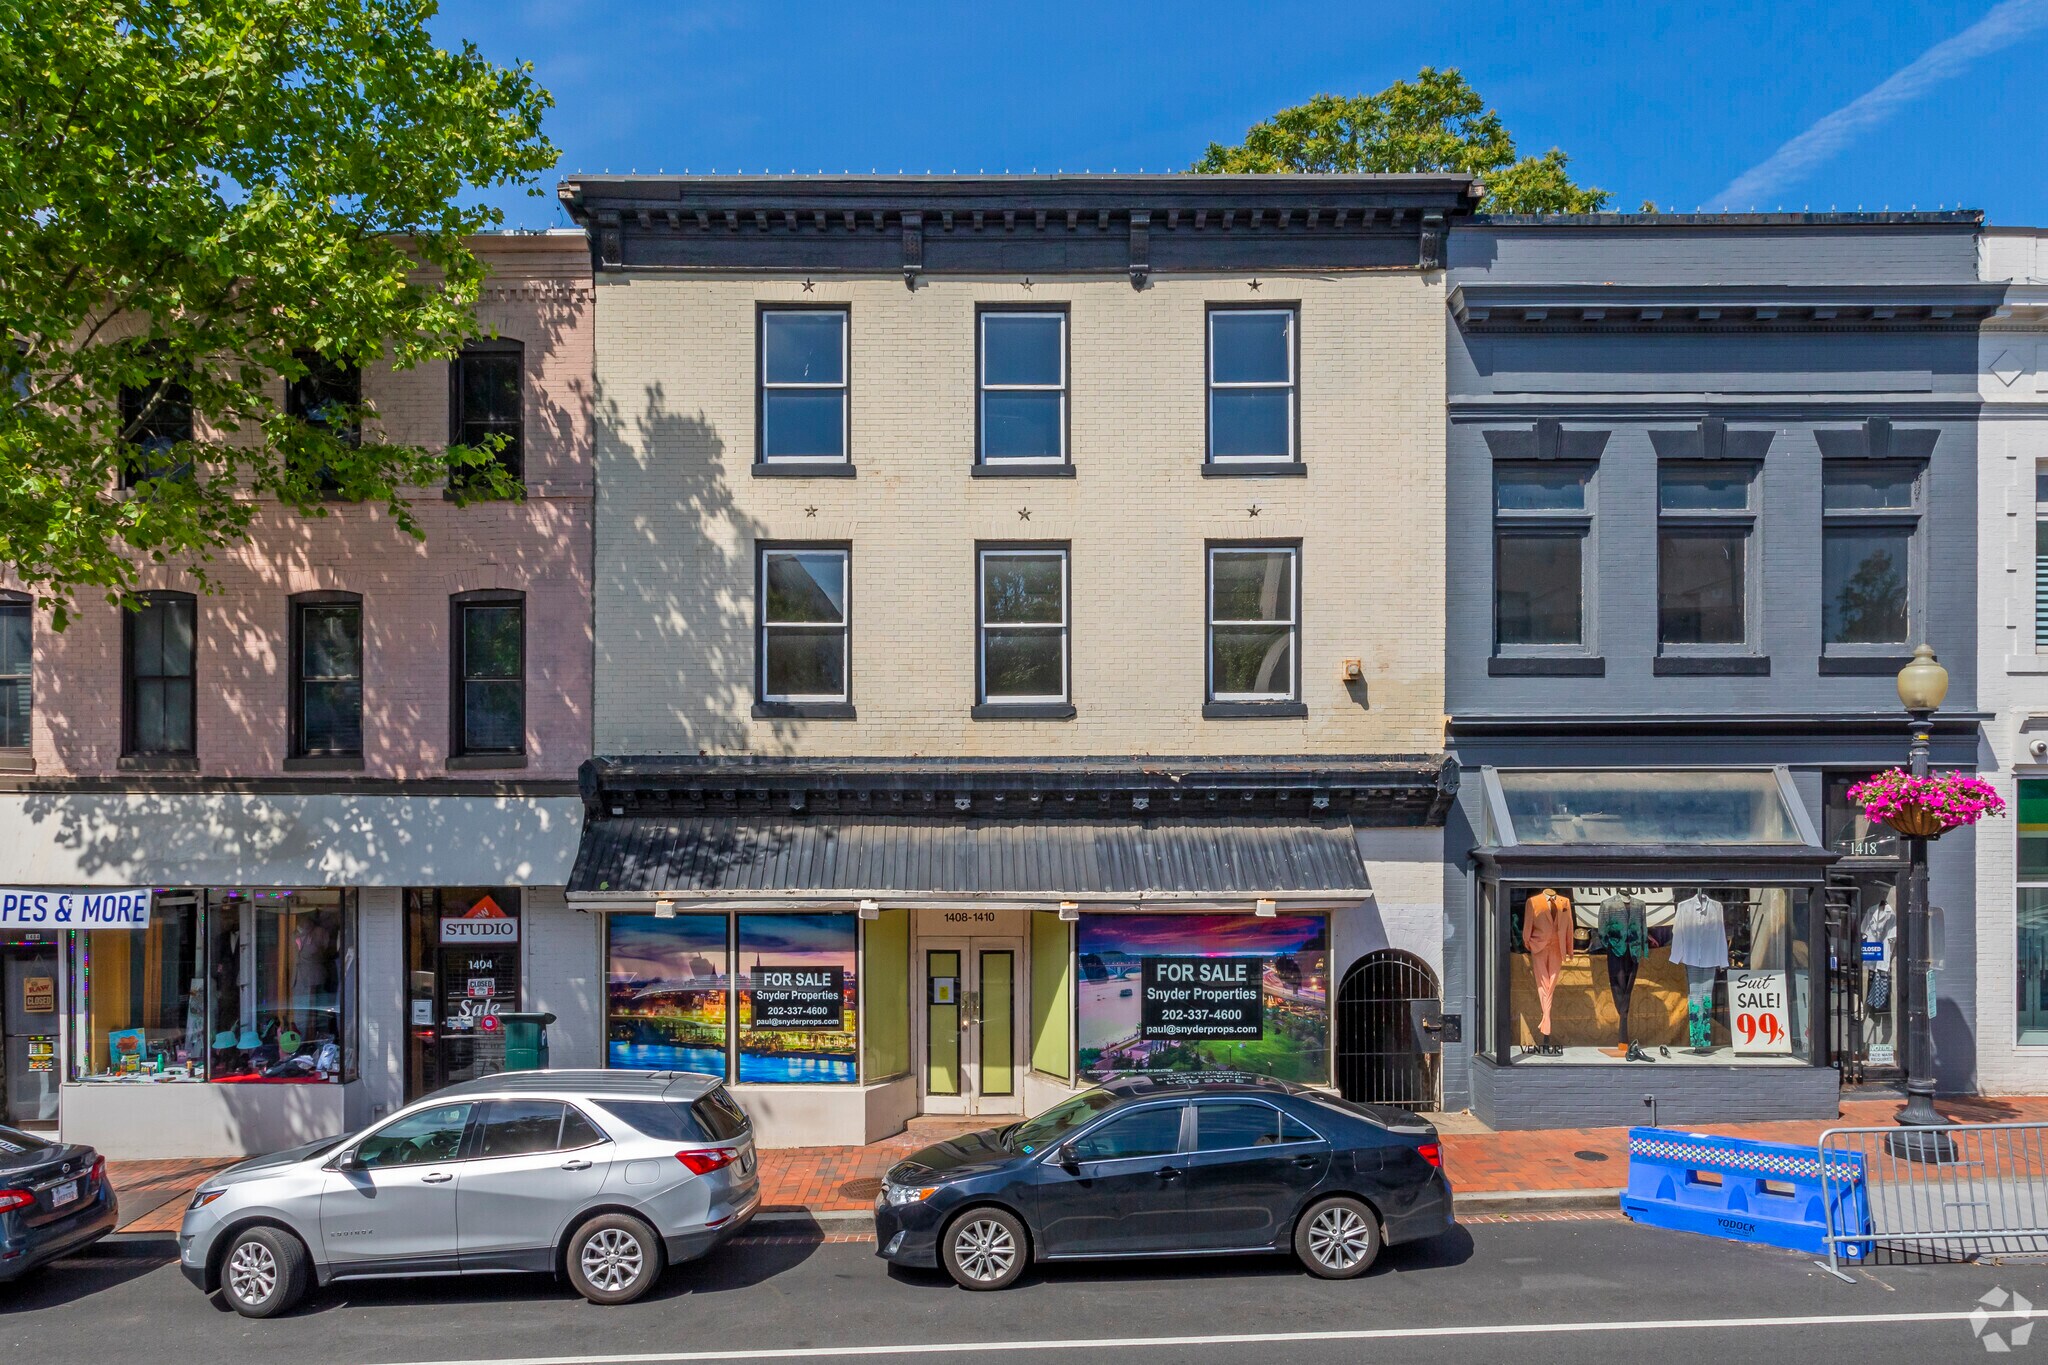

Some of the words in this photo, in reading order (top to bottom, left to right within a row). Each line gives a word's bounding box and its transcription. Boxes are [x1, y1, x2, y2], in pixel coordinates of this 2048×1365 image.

[1850, 842, 1877, 855] 1418
[2, 894, 48, 922] PES
[54, 895, 73, 922] &
[81, 895, 147, 922] MORE
[944, 912, 995, 922] 1408-1410
[445, 922, 514, 936] STUDIO
[467, 959, 493, 970] 1404
[1156, 963, 1195, 982] FOR
[1199, 963, 1248, 982] SALE
[470, 980, 493, 988] CLOSED
[763, 972, 793, 987] FOR
[795, 972, 832, 987] SALE
[1736, 973, 1776, 990] Suit
[28, 984, 50, 993] RAW
[756, 990, 790, 1002] Snyder
[791, 990, 839, 1002] Properties
[1146, 987, 1191, 1003] Snyder
[1193, 987, 1257, 1003] Properties
[1737, 992, 1780, 1009] SALE!
[27, 996, 51, 1006] CLOSED
[458, 998, 500, 1018] Sale
[767, 1006, 828, 1015] 202-337-4600
[1161, 1009, 1242, 1020] 202-337-4600
[756, 1018, 839, 1027] paul@snyderprops.com
[1146, 1024, 1257, 1035] paul@snyderprops.com
[1519, 1044, 1564, 1055] VENTURI
[1717, 1217, 1756, 1233] YODOCK
[330, 1229, 373, 1238] EQUINOX
